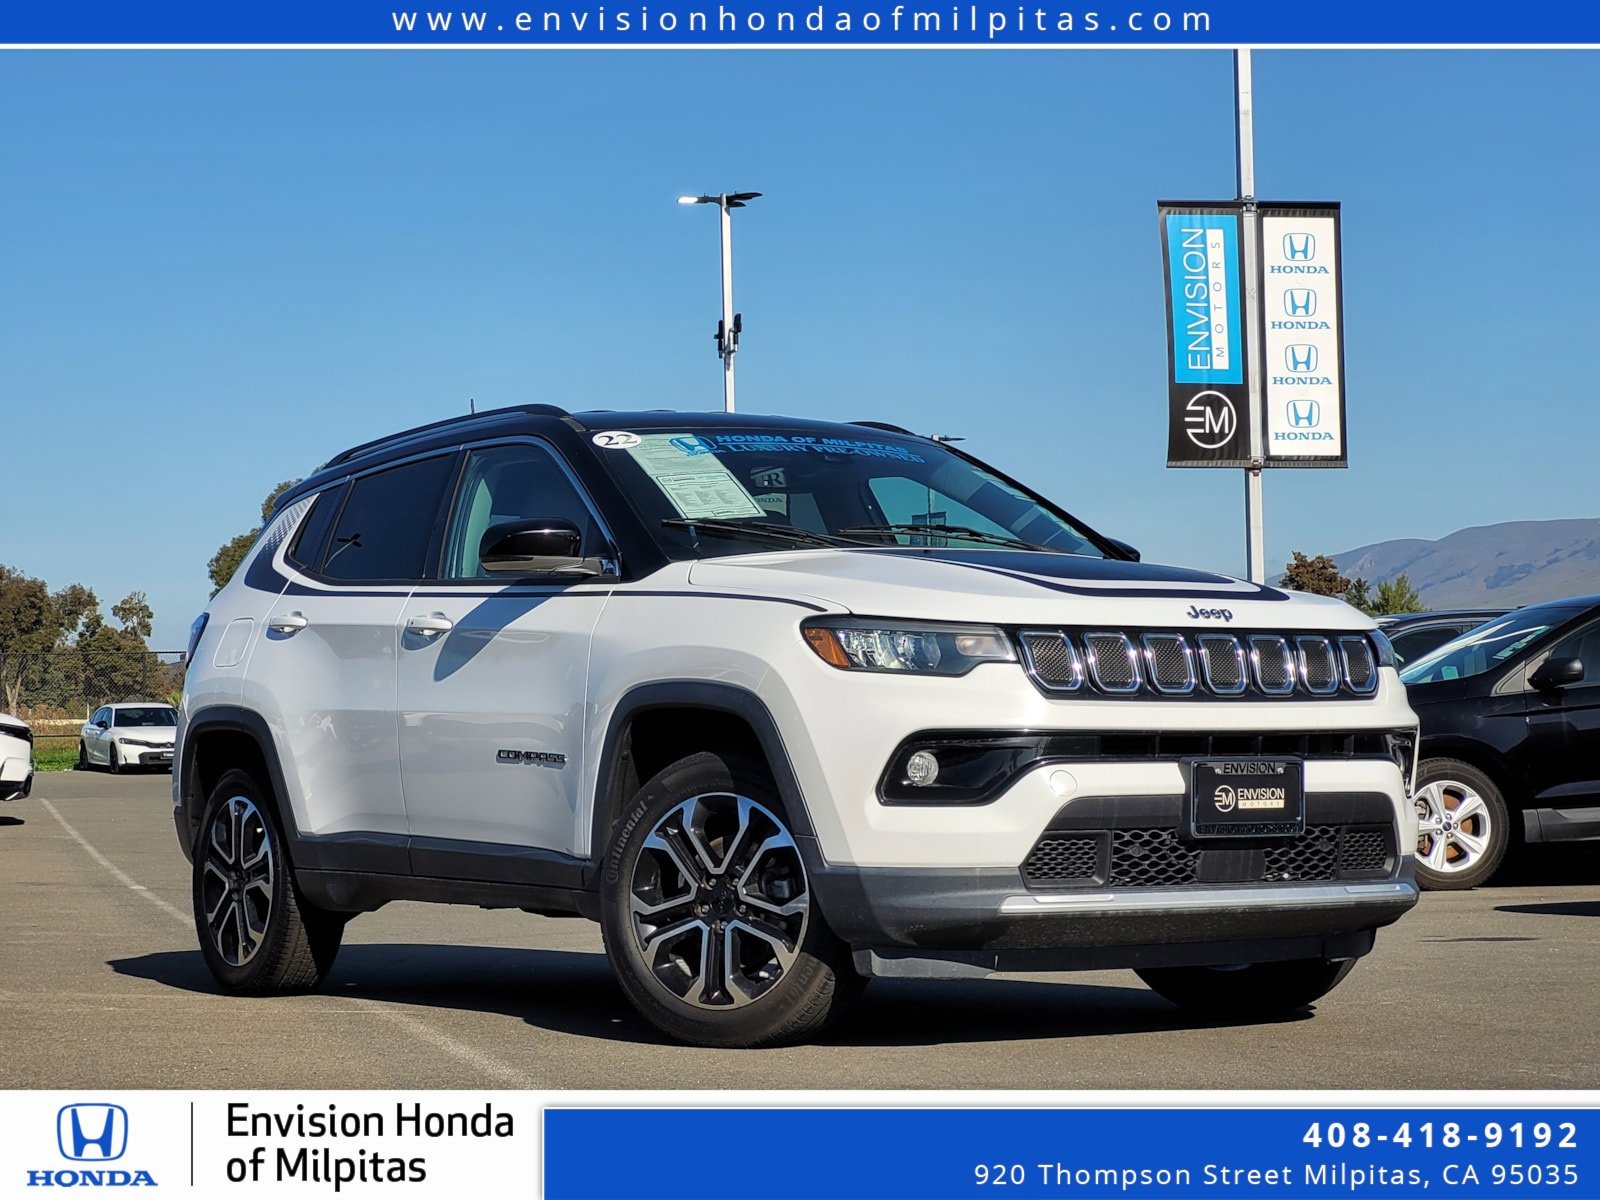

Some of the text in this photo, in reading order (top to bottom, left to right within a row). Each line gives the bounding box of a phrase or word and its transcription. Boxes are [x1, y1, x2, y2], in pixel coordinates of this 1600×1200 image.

[1270, 264, 1329, 275] HONDA
[1181, 228, 1211, 371] ENVISION
[1211, 241, 1225, 358] MOTORS
[1271, 320, 1331, 330] HONDA
[1272, 376, 1333, 386] HONDA
[598, 433, 638, 446] 22
[1274, 431, 1335, 441] HONDA
[717, 435, 910, 454] HONDA OF MILPITAS
[1186, 605, 1233, 622] Jeep
[497, 749, 566, 764] COMPASS
[1223, 763, 1276, 774] ENVISION
[1237, 788, 1285, 800] ENVISION
